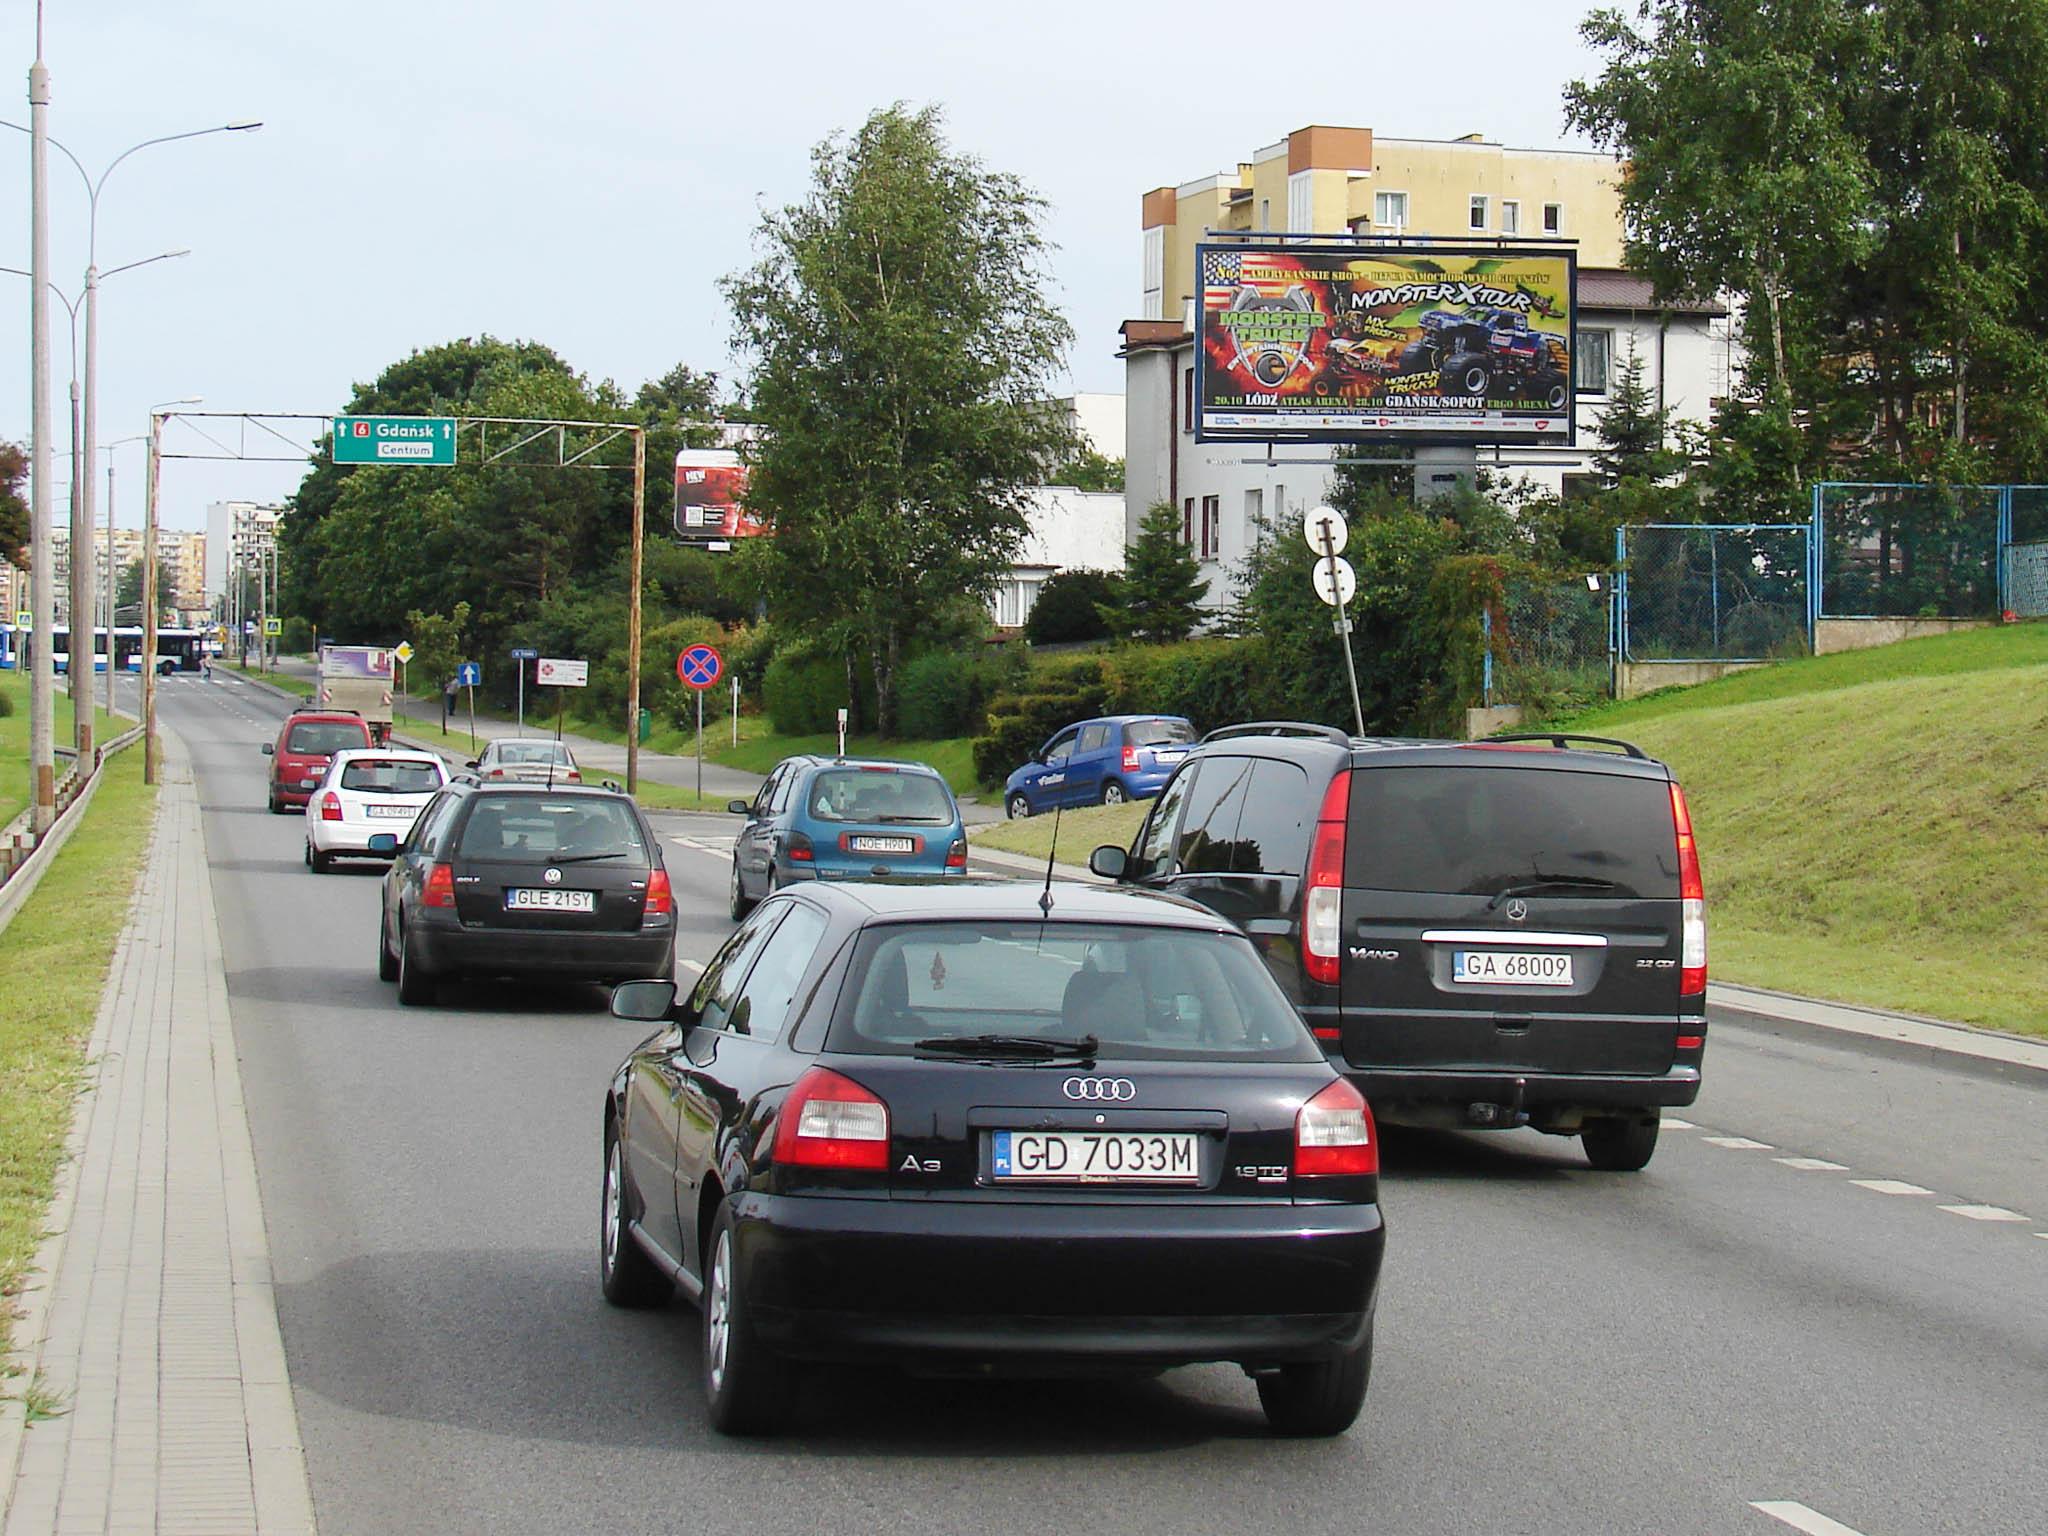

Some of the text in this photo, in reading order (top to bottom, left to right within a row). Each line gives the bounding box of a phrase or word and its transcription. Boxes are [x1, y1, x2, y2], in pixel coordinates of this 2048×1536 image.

[1331, 270, 1361, 281] SHOW
[1219, 311, 1326, 327] MONSTER
[1236, 327, 1310, 342] TRUCK
[1384, 370, 1440, 386] MONSTER
[1388, 380, 1438, 395] TRUCKS!
[1214, 391, 1349, 408] 20.10 ŁÓDŹ ATLAS ARENA
[1385, 392, 1485, 410] GDAŃSK/SOPOT
[1486, 399, 1515, 410] ERGO
[1517, 399, 1551, 411] ARENA
[358, 422, 435, 438] 6 Gdańsk
[381, 444, 431, 455] Centrum
[859, 839, 909, 850] NOE H901
[518, 890, 590, 907] GLE 21SY
[1349, 947, 1399, 960] VIANO
[1468, 955, 1567, 976] GA 68009
[1018, 1136, 1191, 1171] GD 7033M
[899, 1154, 941, 1172] A3
[996, 1158, 1010, 1168] PL
